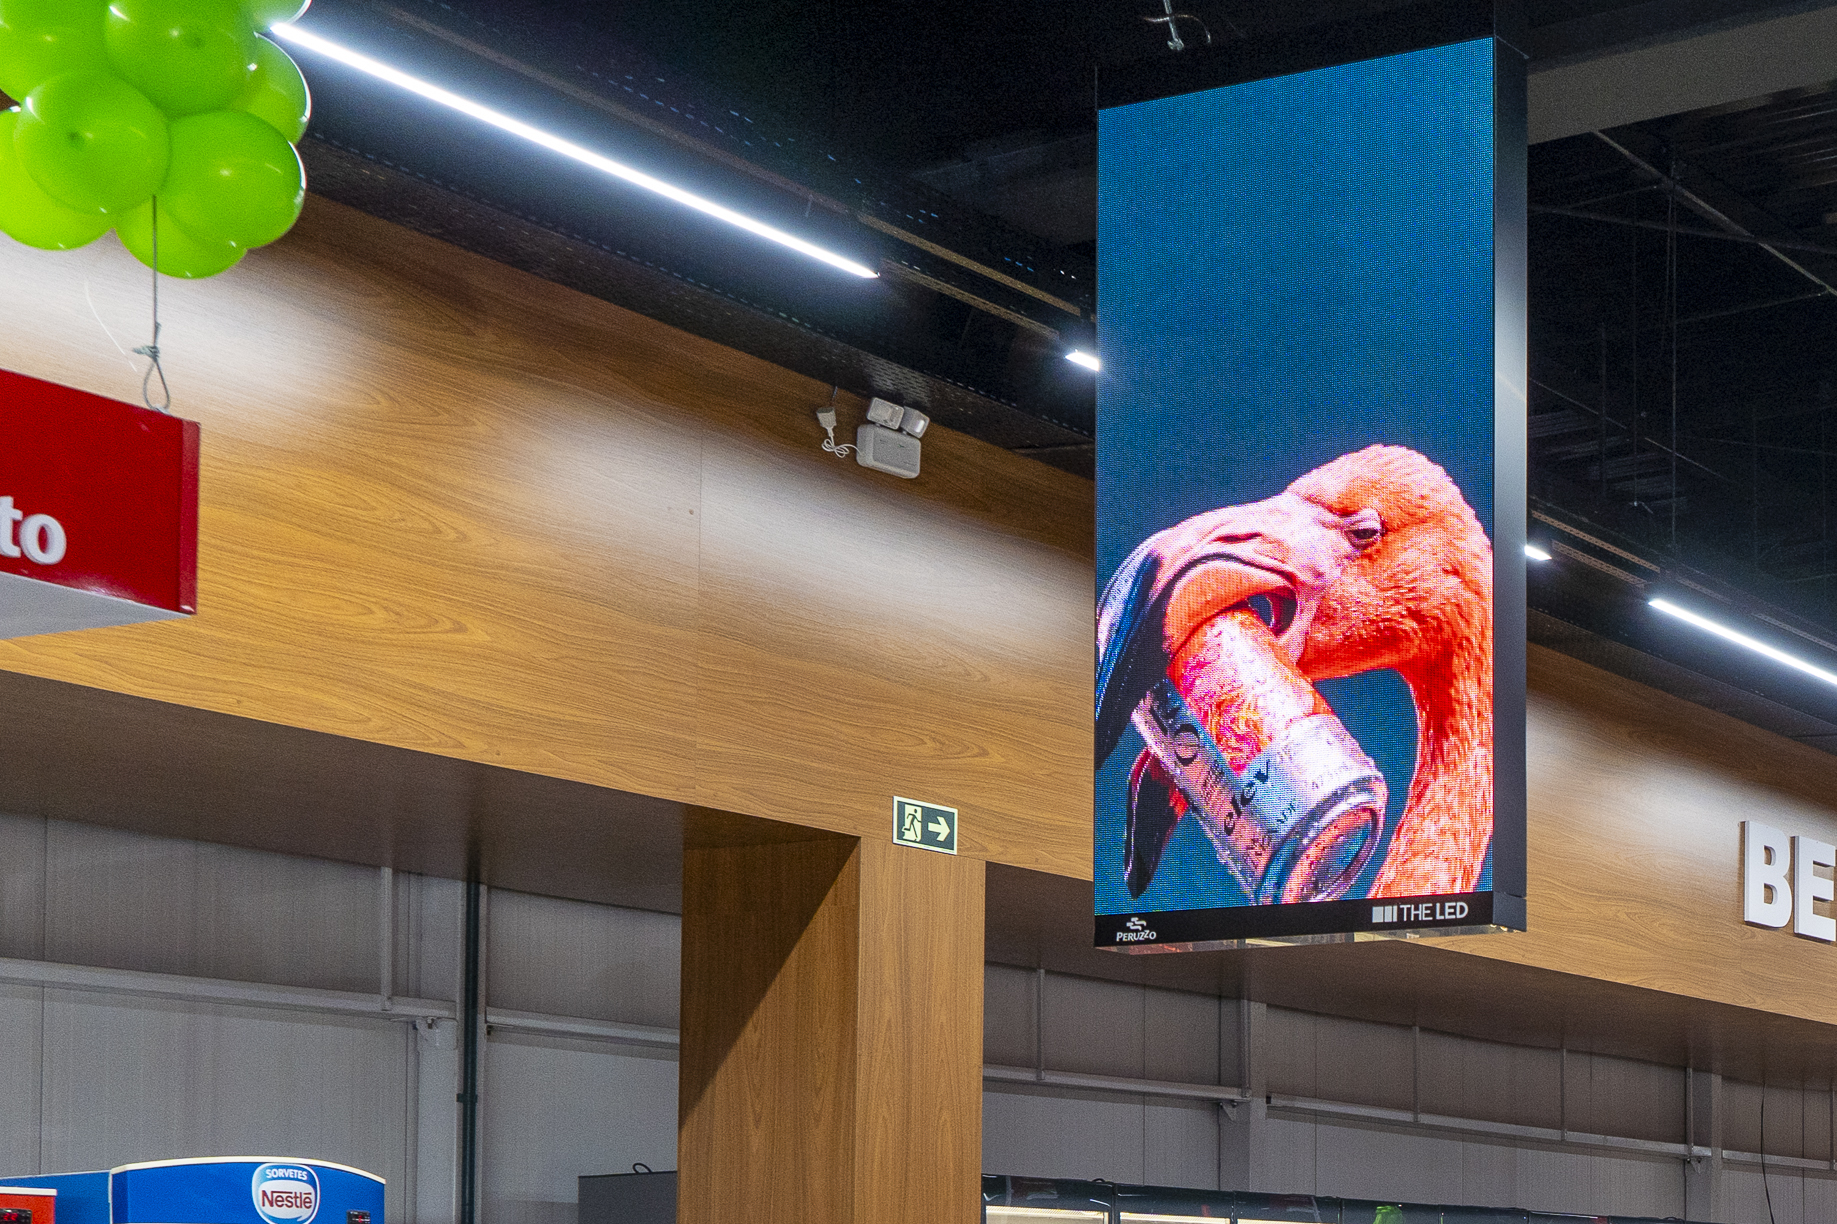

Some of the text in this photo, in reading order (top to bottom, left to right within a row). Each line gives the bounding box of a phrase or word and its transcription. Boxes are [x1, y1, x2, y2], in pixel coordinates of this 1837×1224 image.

[1400, 902, 1468, 921] THE LED
[1116, 930, 1156, 942] PERUZZO
[265, 1168, 308, 1181] SORVETES
